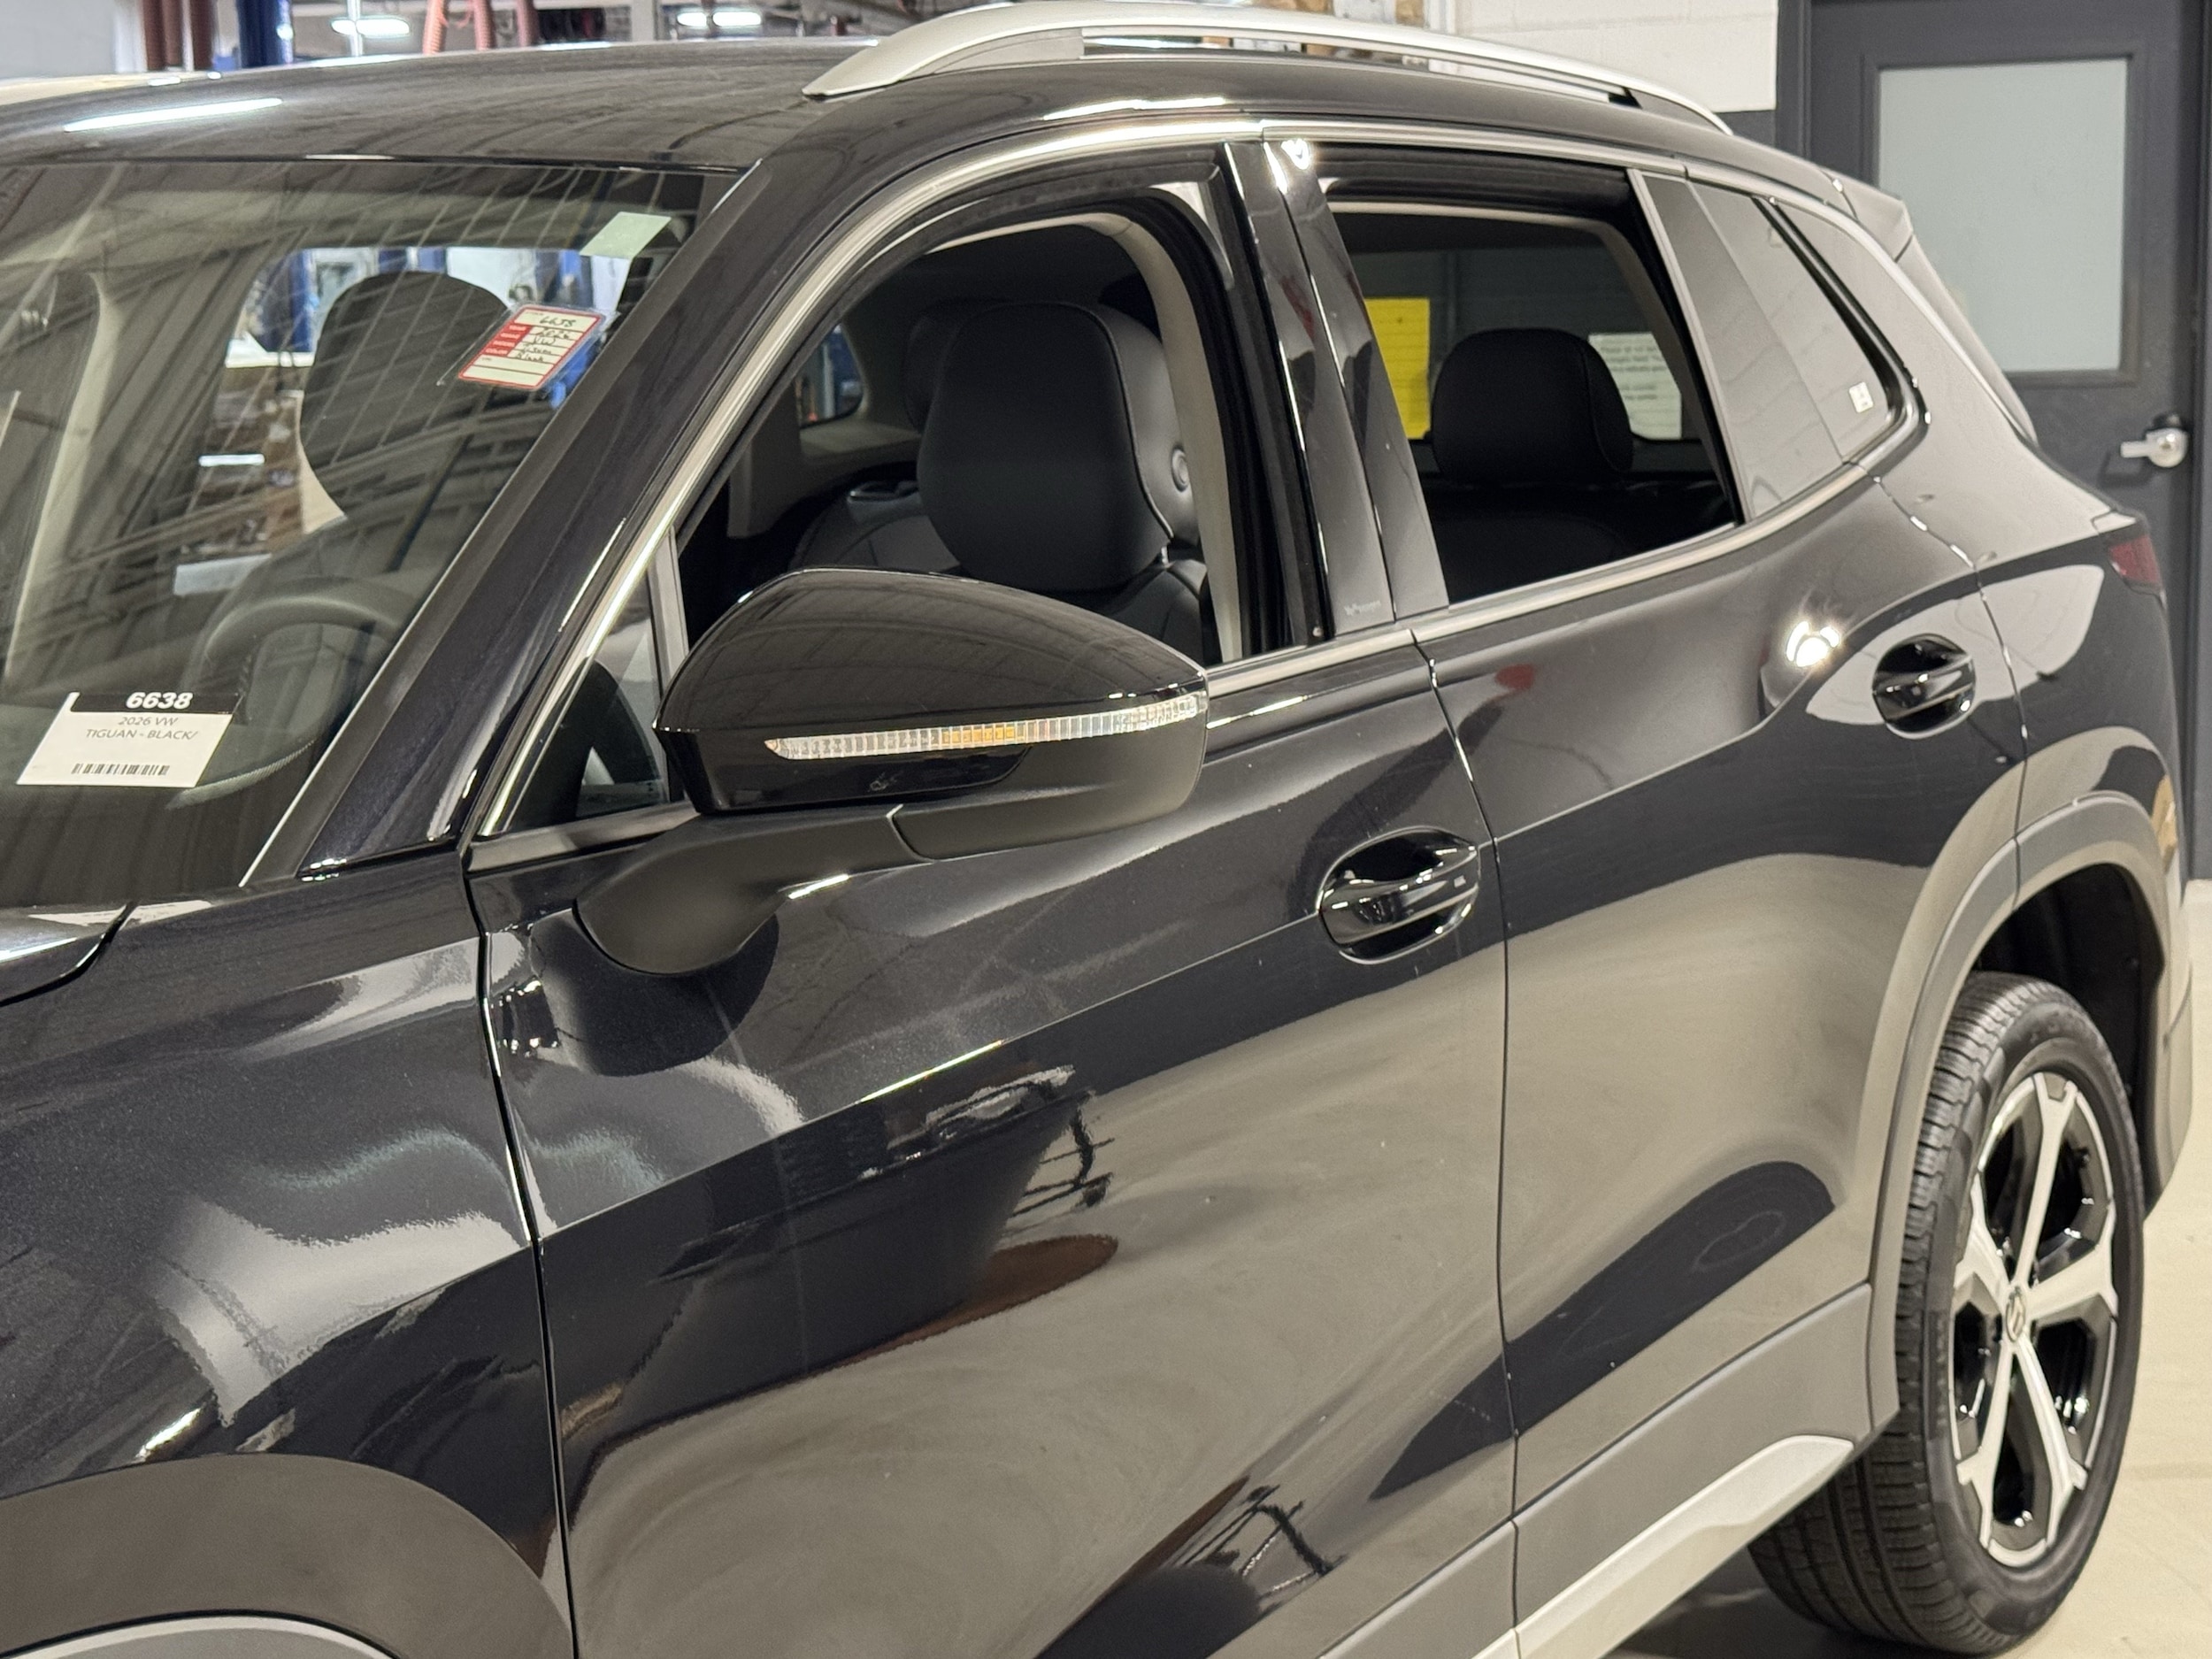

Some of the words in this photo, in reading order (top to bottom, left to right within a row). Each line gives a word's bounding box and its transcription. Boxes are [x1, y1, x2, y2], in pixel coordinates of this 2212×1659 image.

[126, 692, 193, 710] 6638
[118, 717, 151, 726] 2026
[155, 717, 179, 726] VW
[86, 729, 137, 739] TIGUAN
[147, 730, 198, 740] BLACK/
